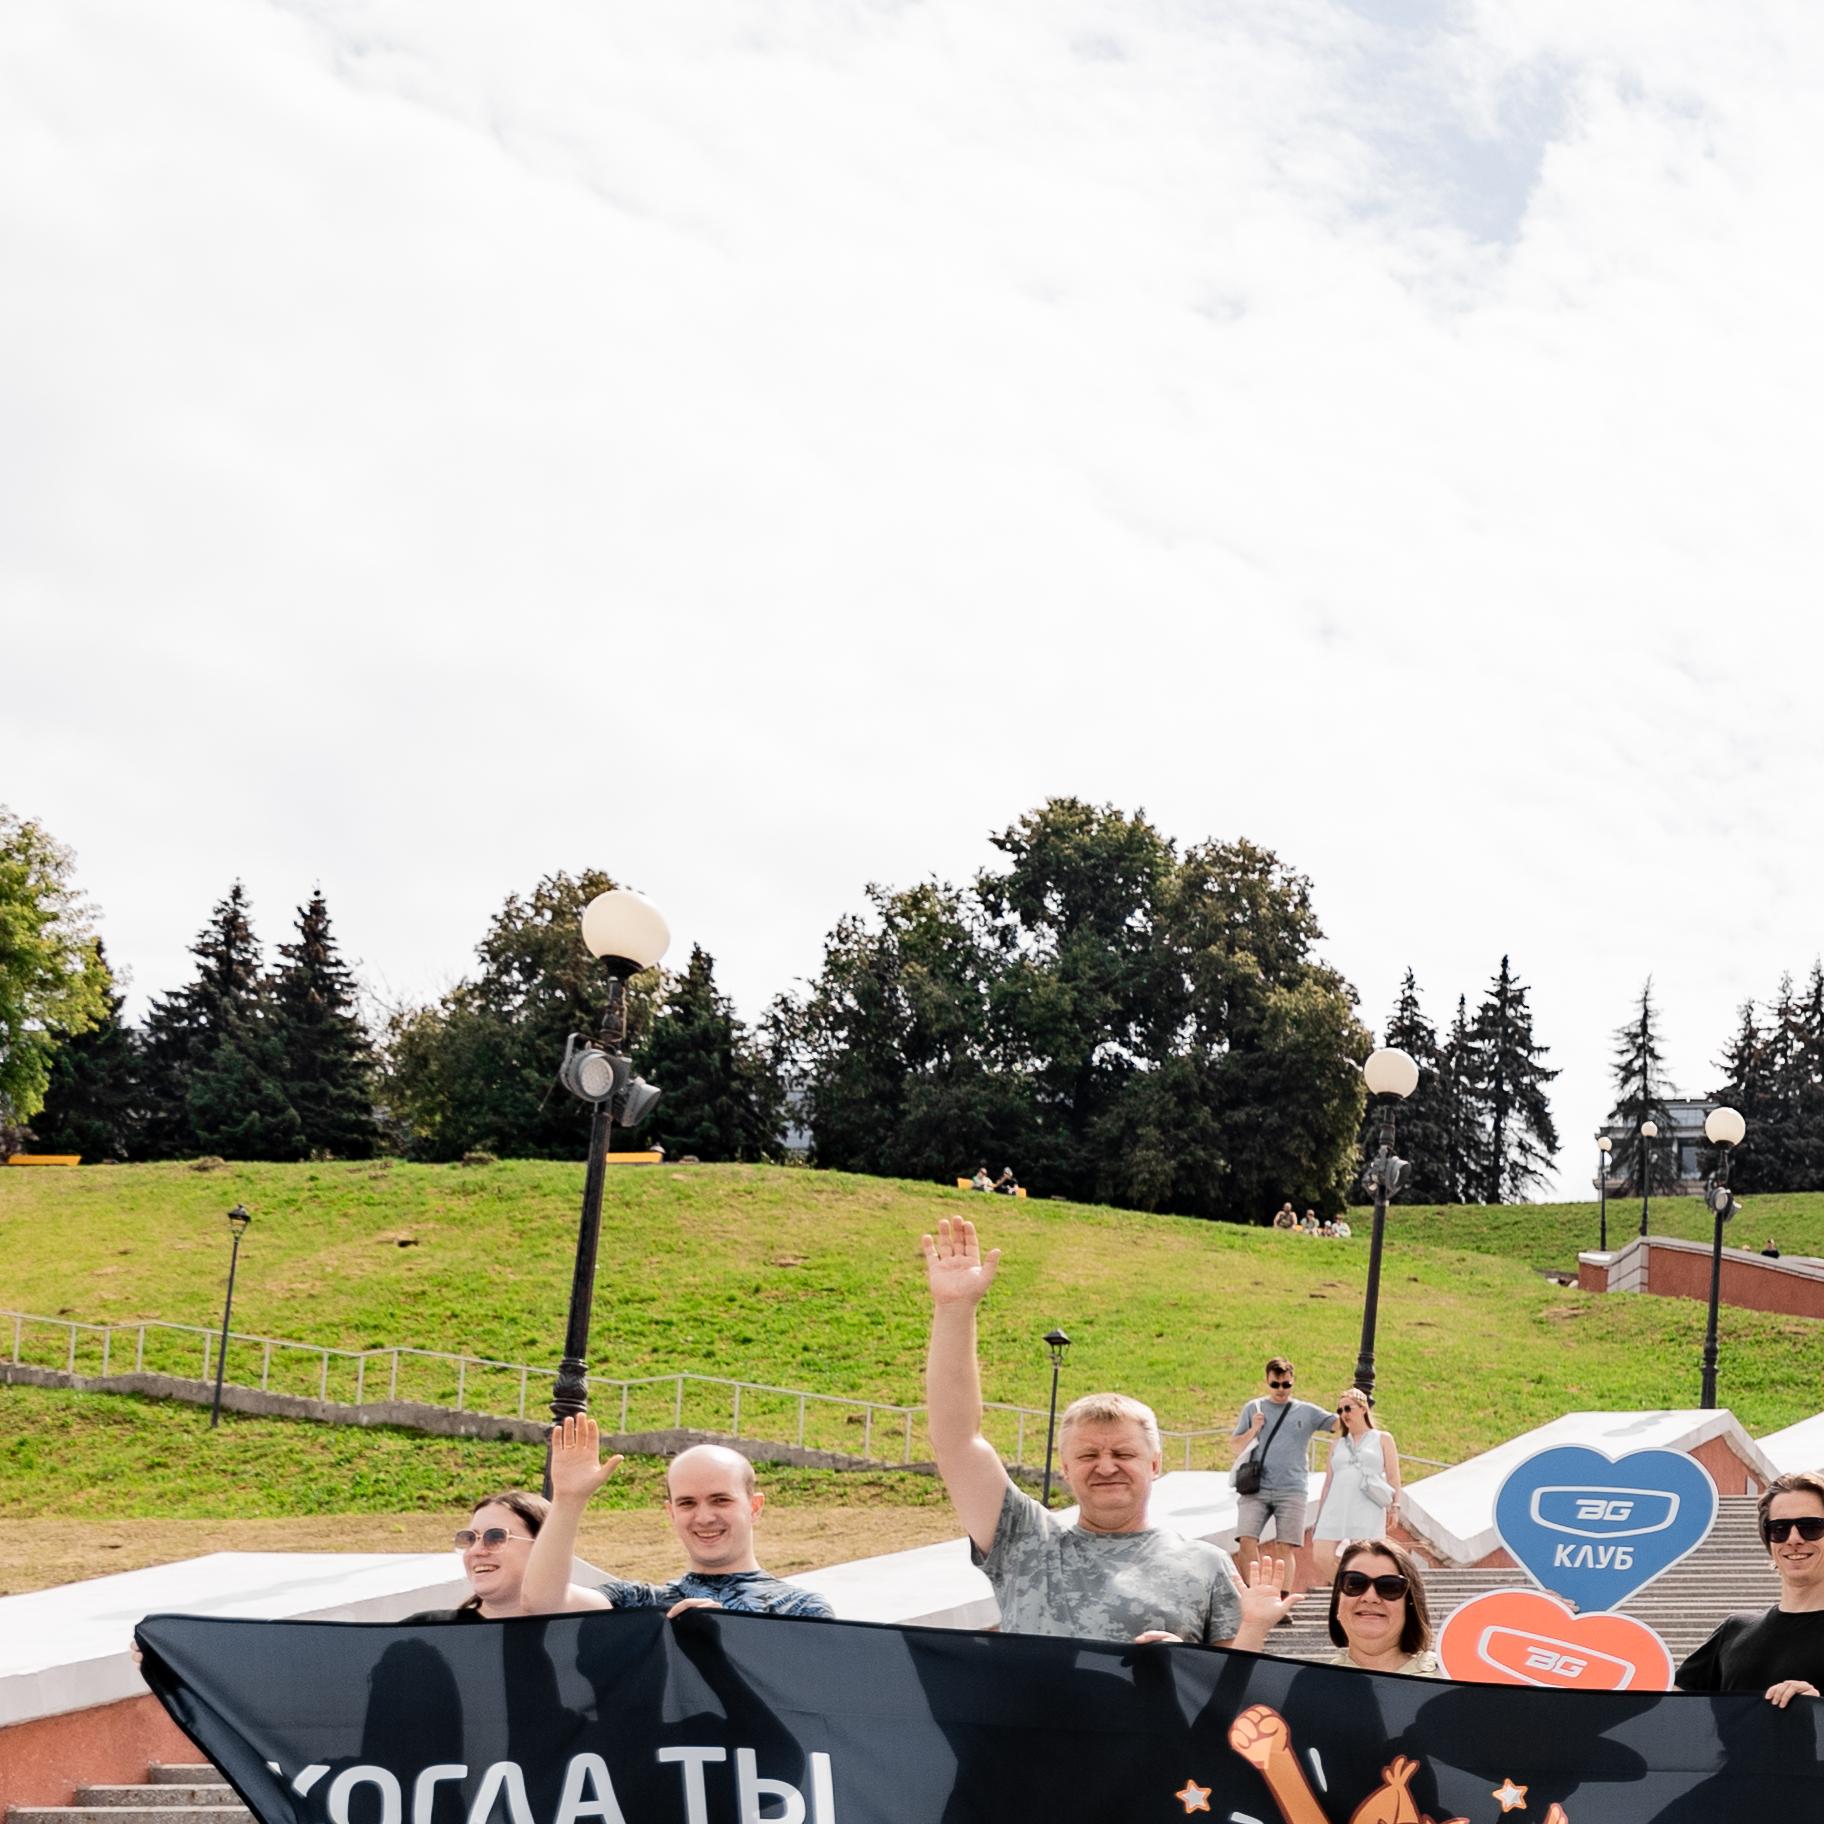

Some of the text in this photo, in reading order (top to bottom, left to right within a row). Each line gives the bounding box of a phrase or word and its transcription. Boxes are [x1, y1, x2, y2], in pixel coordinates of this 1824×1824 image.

[1575, 1498, 1635, 1522] BG
[1553, 1543, 1635, 1571] КЛУБ
[1524, 1645, 1588, 1678] BG
